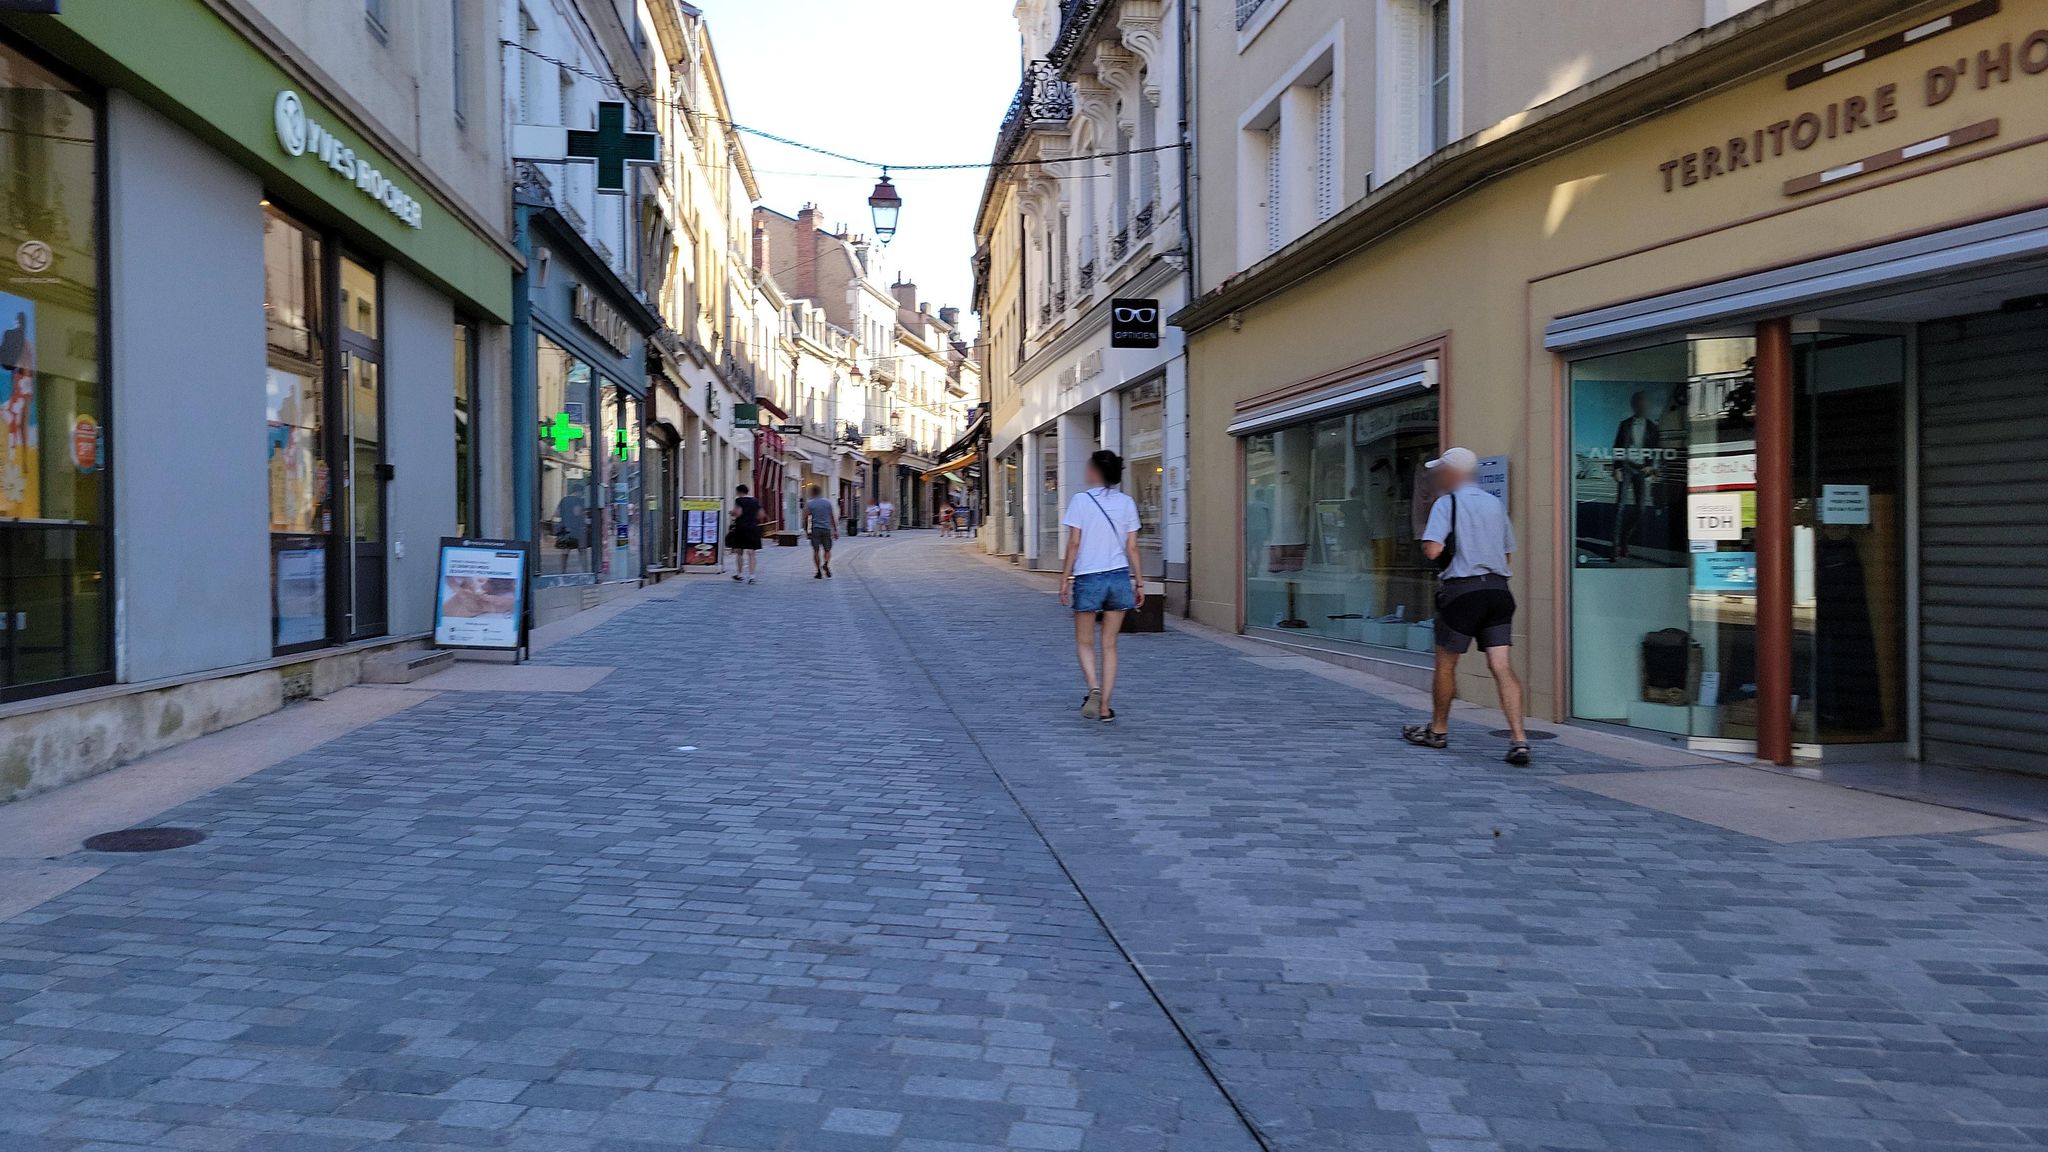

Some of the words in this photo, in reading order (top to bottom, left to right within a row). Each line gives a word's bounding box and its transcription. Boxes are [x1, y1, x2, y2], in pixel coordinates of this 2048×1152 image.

[1659, 83, 1898, 192] TERRITOIRE
[1924, 29, 2048, 107] D'HO
[306, 118, 357, 180] YVES
[355, 159, 422, 230] ROCHER
[1114, 331, 1158, 340] OPTICIEN
[1589, 447, 1678, 461] ALBERTO
[1696, 516, 1734, 529] TDH
